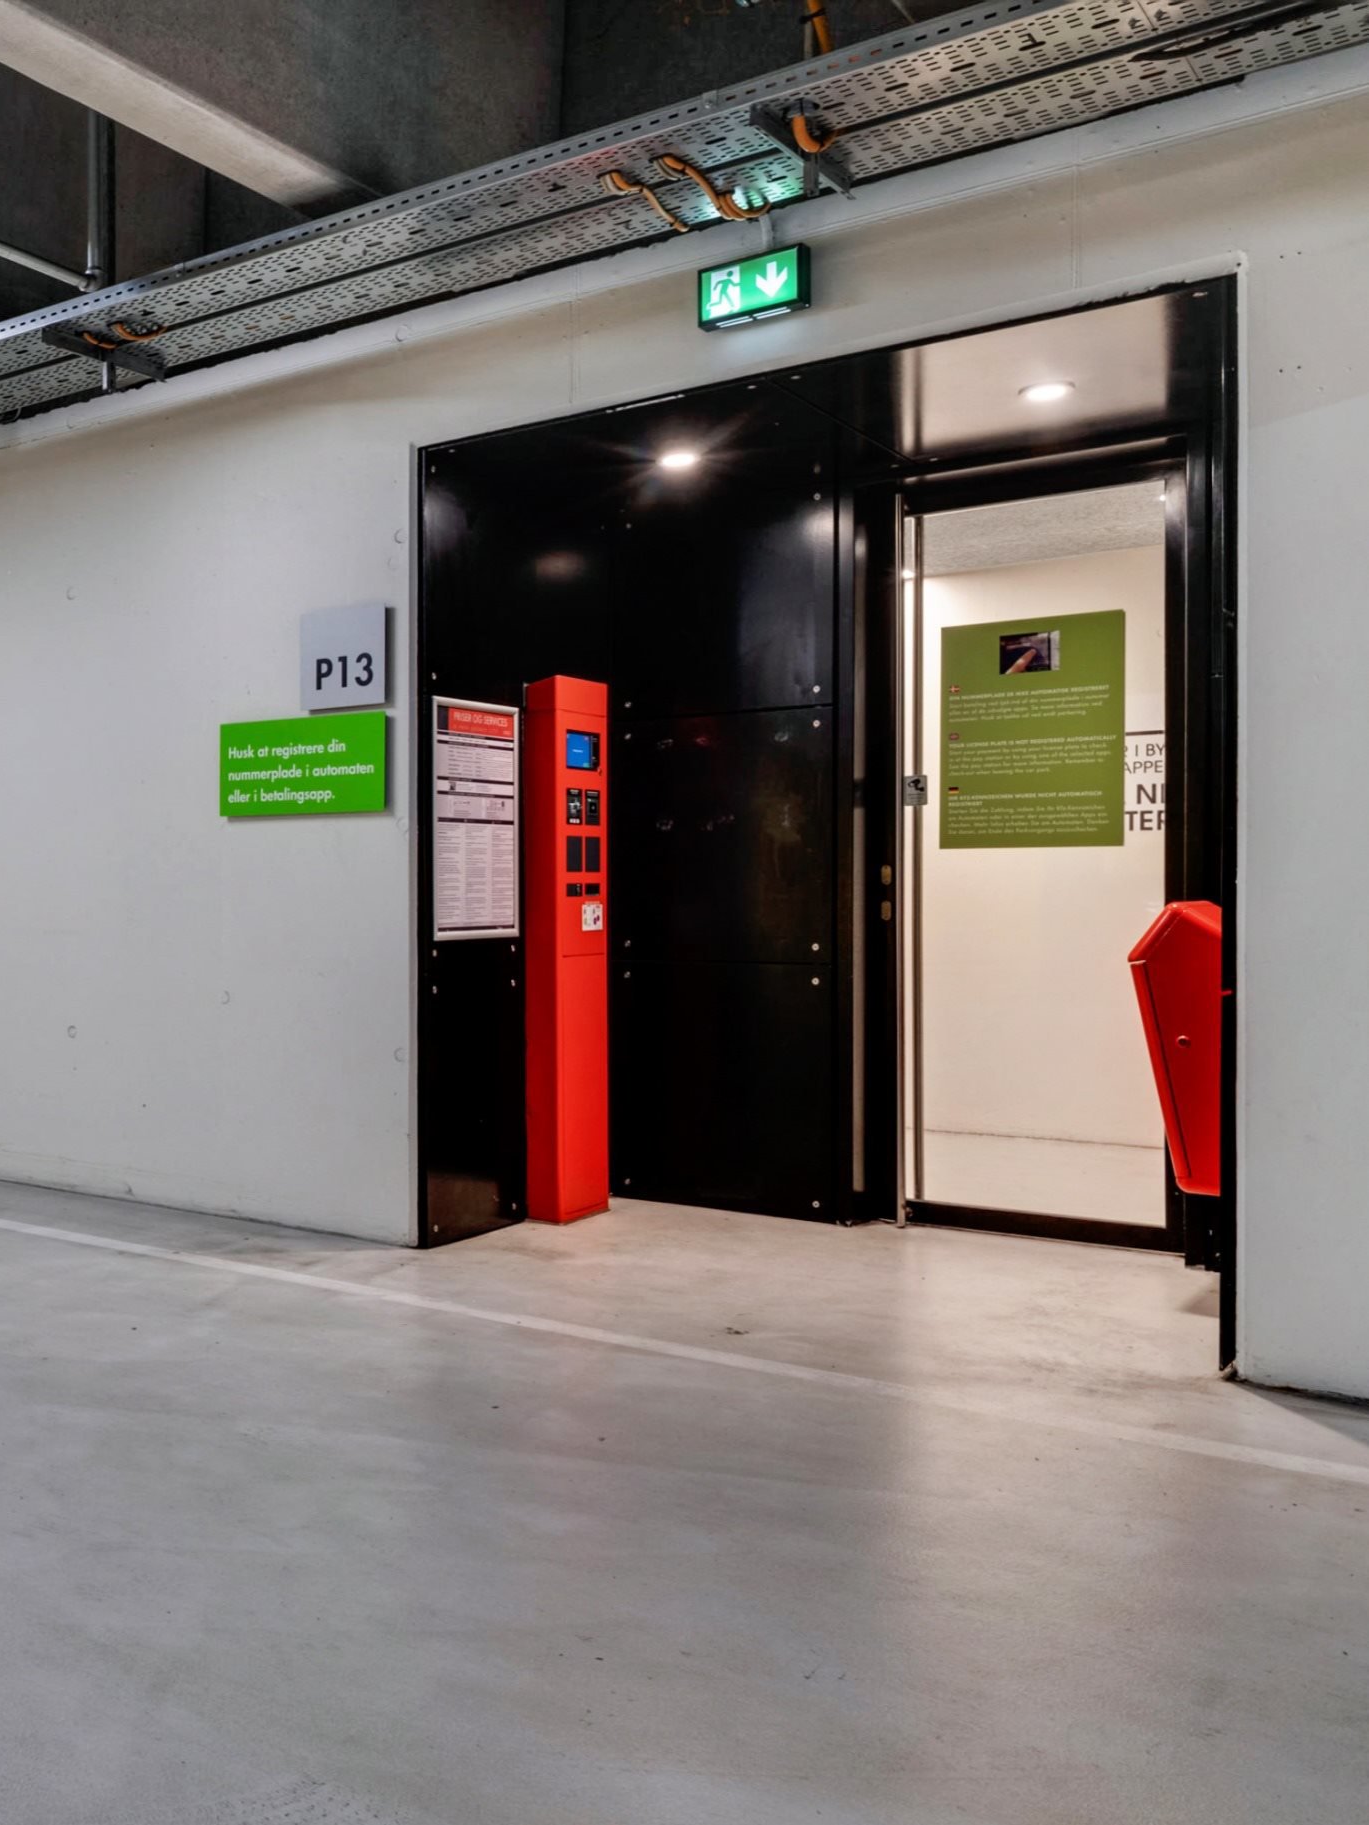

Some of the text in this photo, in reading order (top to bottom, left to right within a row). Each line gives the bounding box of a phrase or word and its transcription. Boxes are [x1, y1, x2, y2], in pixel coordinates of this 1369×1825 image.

[315, 652, 374, 691] P13
[228, 739, 346, 760] Husk at registrere din
[228, 763, 374, 783] nummerplade i automaten
[228, 787, 335, 804] eller i betalingsapp.
